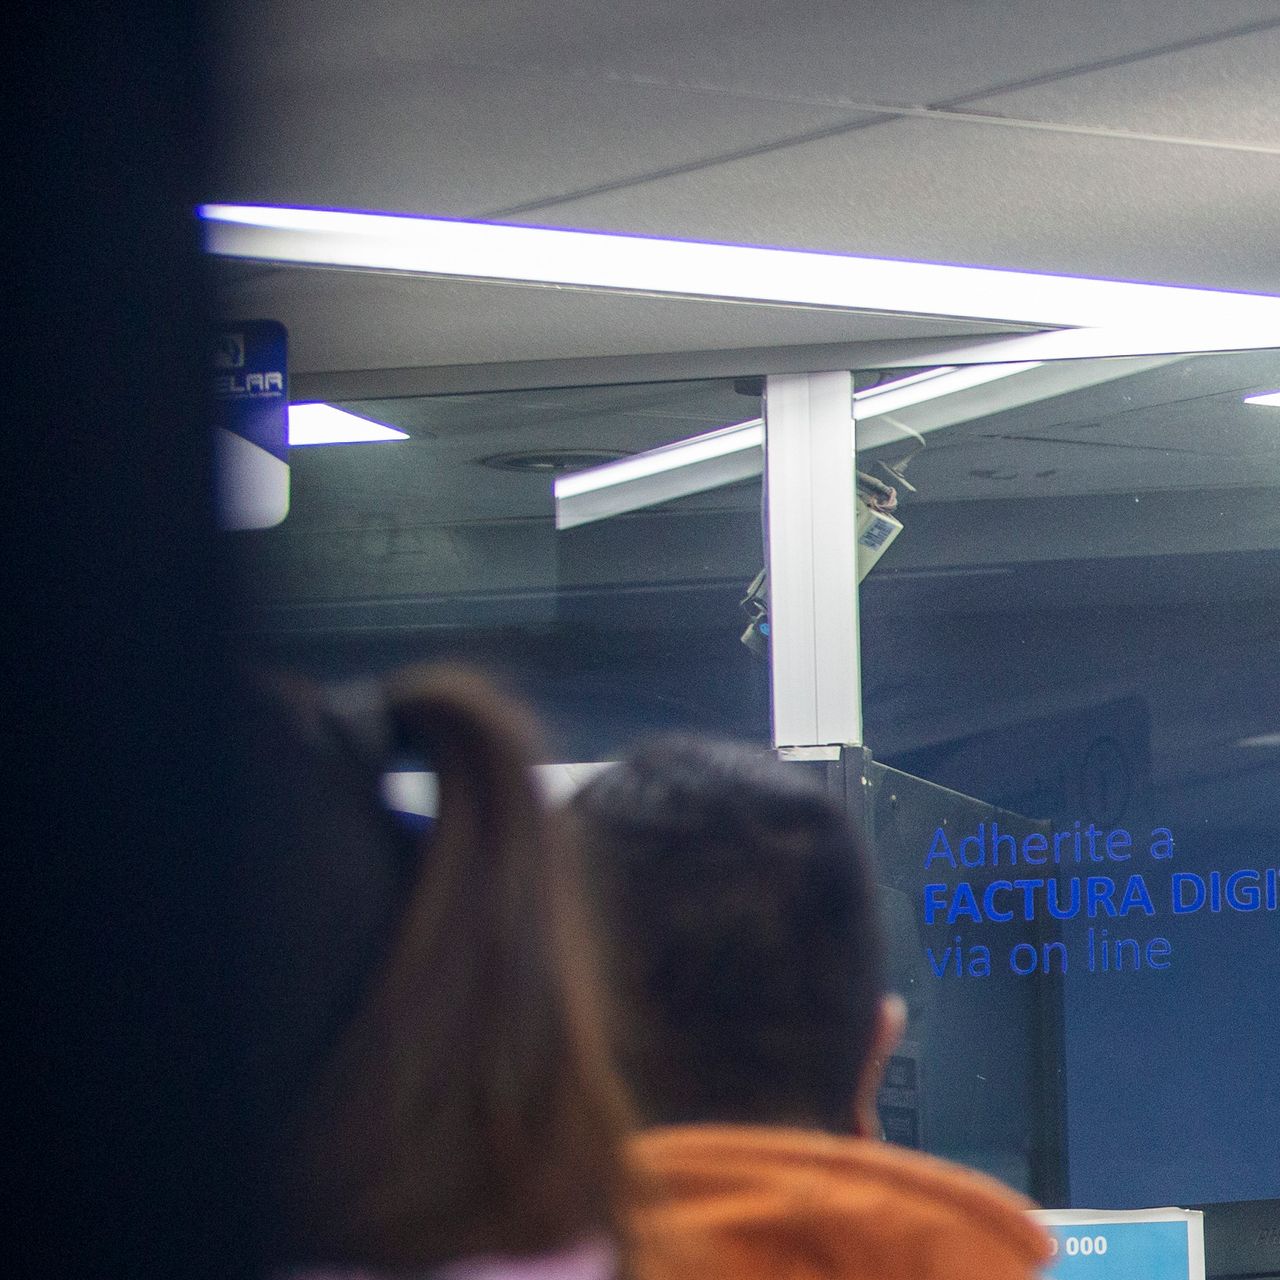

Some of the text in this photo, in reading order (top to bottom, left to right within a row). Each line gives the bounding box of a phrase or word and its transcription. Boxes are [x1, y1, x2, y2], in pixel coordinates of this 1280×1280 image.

[924, 821, 1174, 869] Adherite a
[924, 874, 1156, 925] FACTURA
[926, 929, 1172, 978] via on line
[1065, 1235, 1108, 1256] 000
